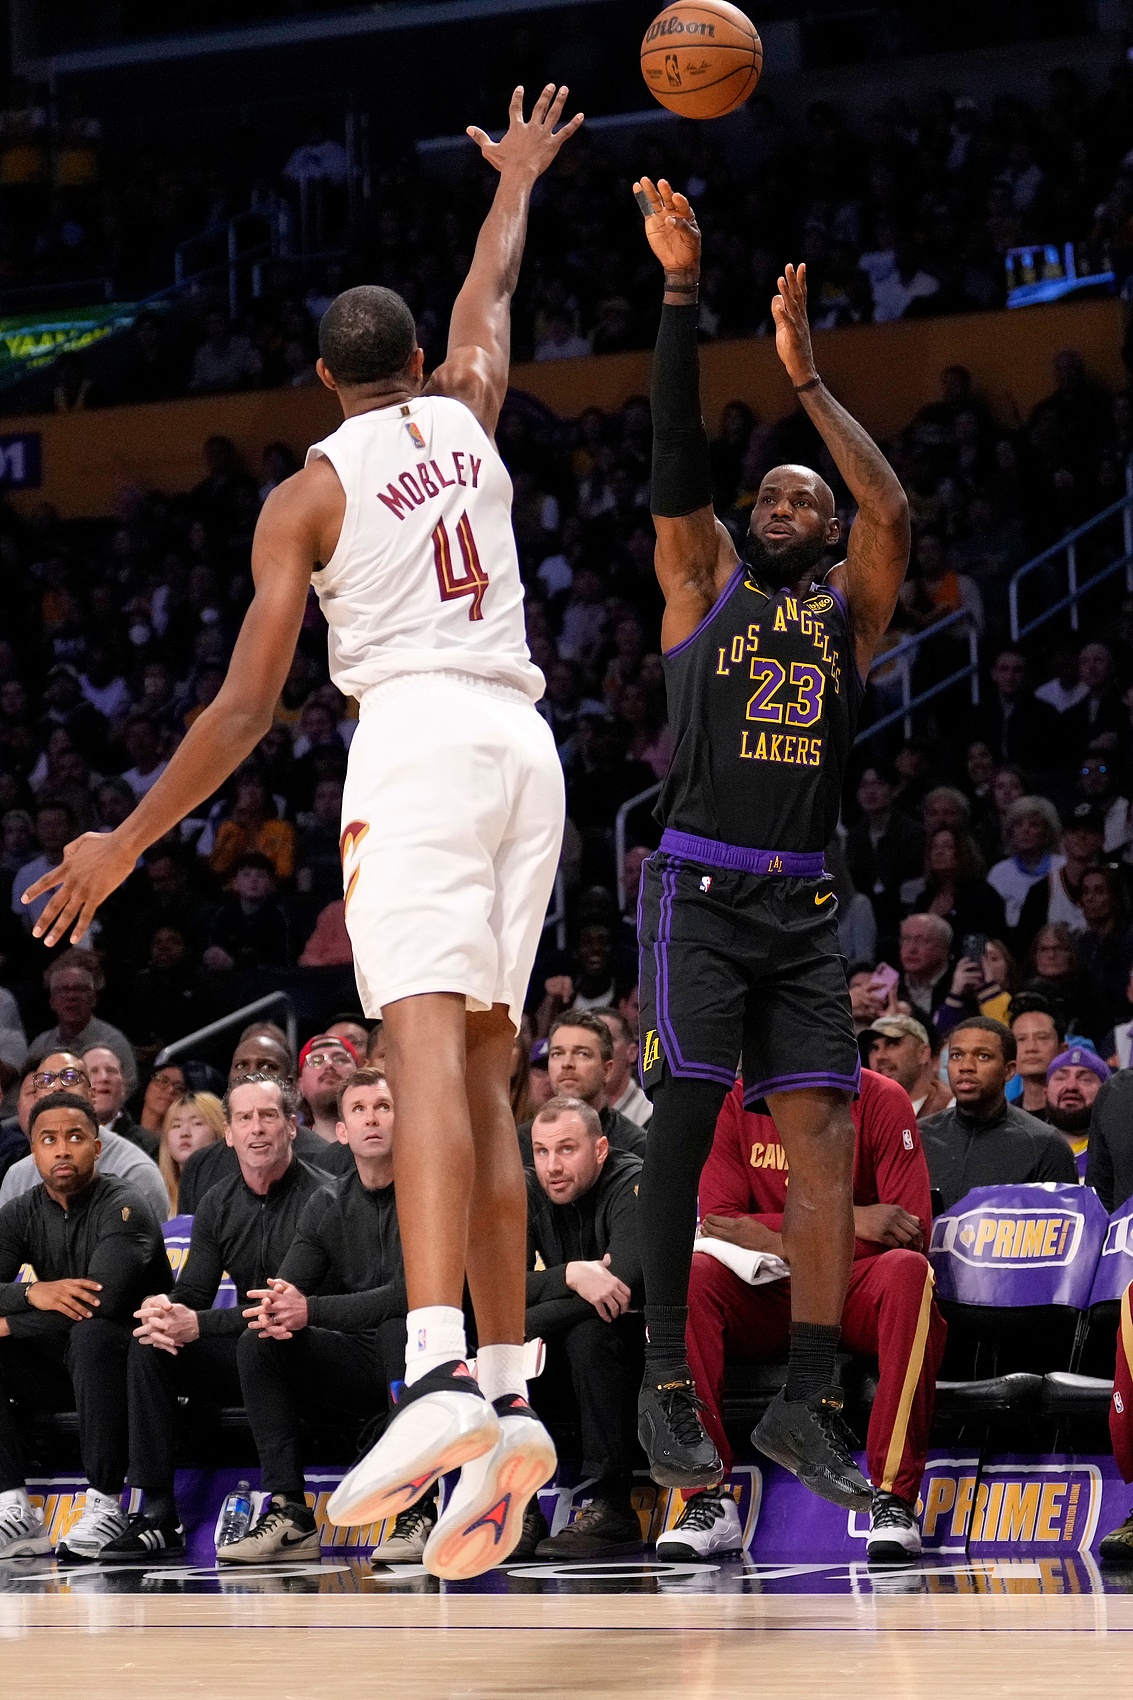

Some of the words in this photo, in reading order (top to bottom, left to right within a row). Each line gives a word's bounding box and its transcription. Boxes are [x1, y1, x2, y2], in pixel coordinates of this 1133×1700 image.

[646, 16, 716, 44] Wilson
[377, 451, 482, 521] MOBLEY
[431, 508, 490, 622] 4
[716, 624, 760, 675] LOS
[773, 596, 841, 694] ANGELES
[745, 656, 826, 728] 23
[740, 730, 822, 766] LAKERS
[643, 1029, 661, 1073] LA
[973, 1218, 1063, 1259] PRIME
[921, 1477, 1068, 1543] PRIME
[1069, 1483, 1081, 1504] DRINK
[1062, 1504, 1078, 1542] HYDRATION
